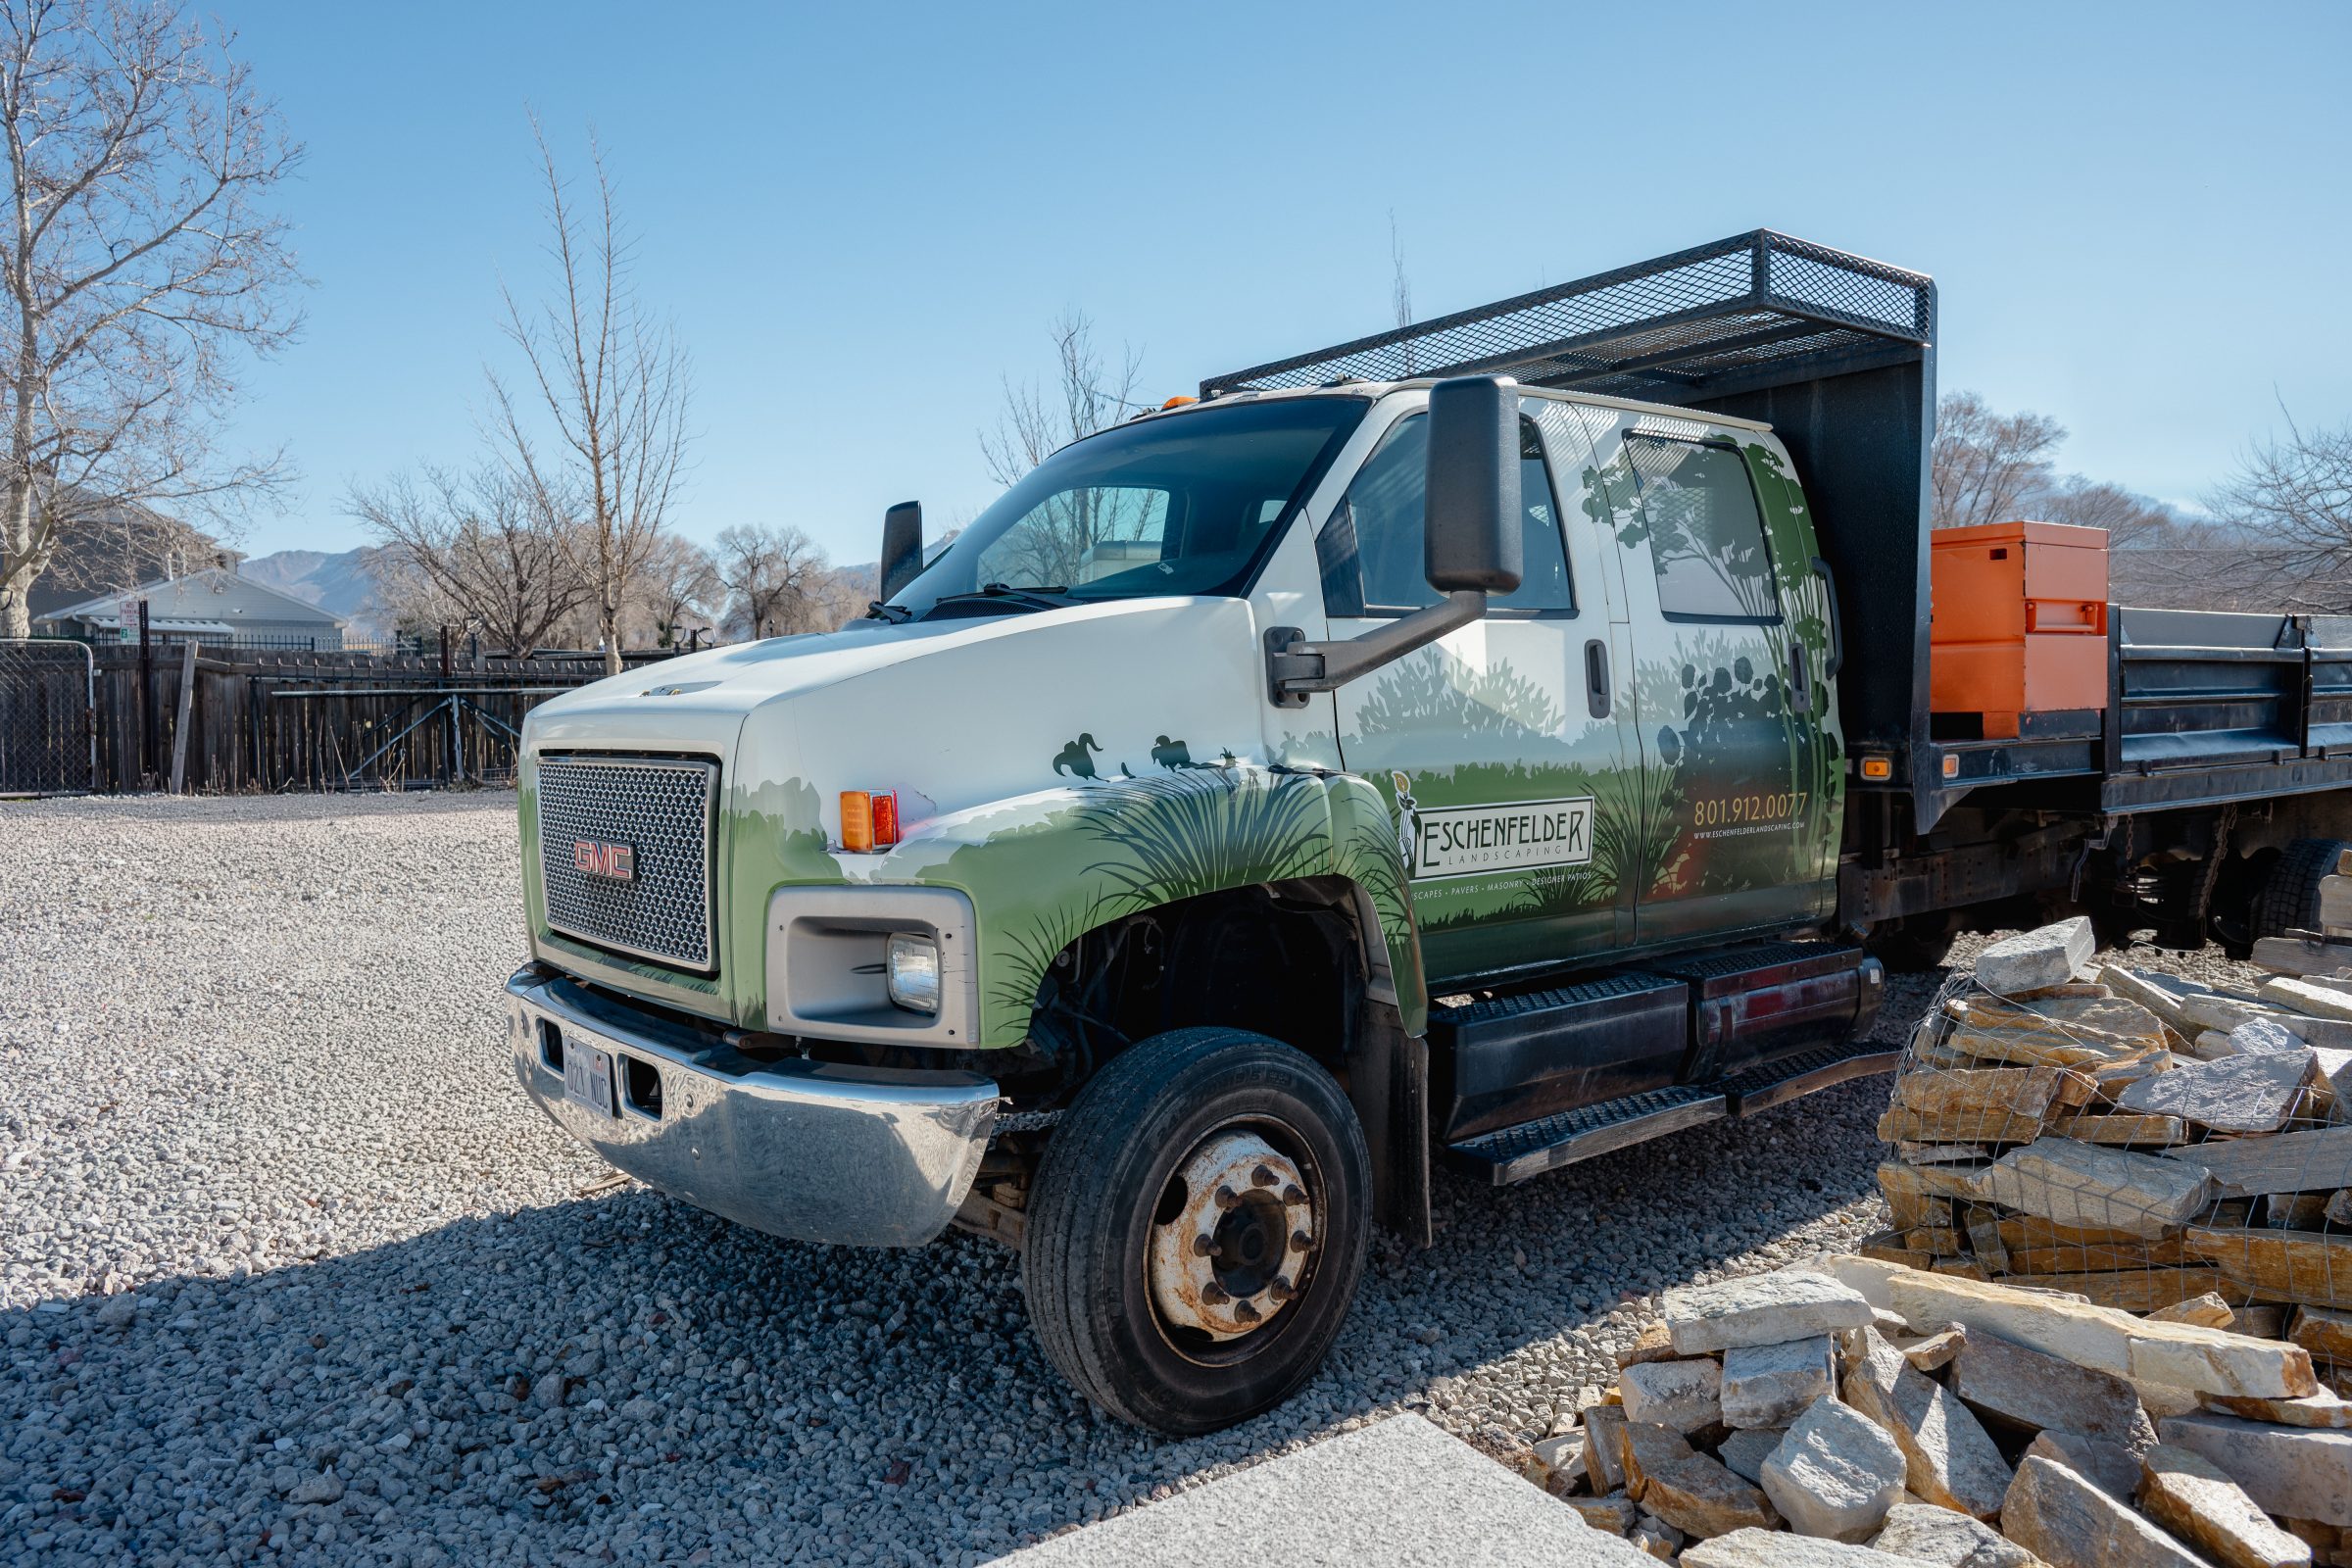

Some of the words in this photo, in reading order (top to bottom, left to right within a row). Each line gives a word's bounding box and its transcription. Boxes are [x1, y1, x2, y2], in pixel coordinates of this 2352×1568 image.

[1694, 792, 1807, 826] 801.912.0077
[1423, 809, 1585, 867] ESCHENFELDER
[1448, 845, 1562, 865] LANDSCAPING
[575, 839, 632, 879] GMC
[1411, 889, 1443, 901] SCAPES
[1450, 884, 1479, 896] PAVERS
[1487, 879, 1524, 892] MASONRY
[1532, 874, 1565, 886] DESIGNER
[1567, 871, 1592, 882] PATIOS
